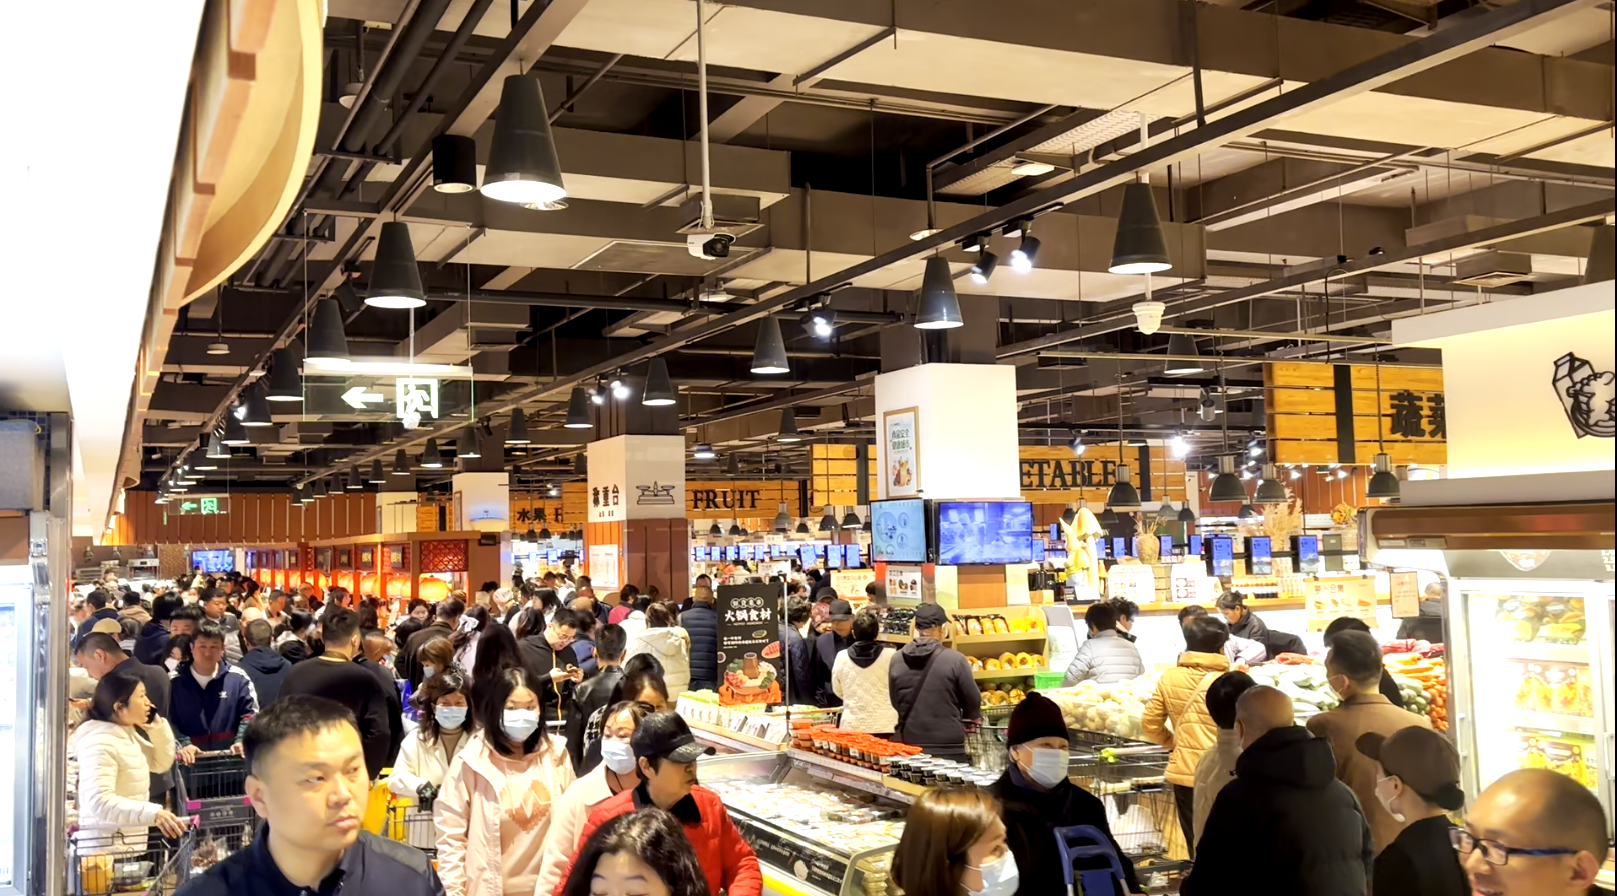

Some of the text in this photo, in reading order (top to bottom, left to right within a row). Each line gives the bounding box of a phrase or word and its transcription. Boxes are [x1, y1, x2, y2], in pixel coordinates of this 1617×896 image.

[1389, 390, 1447, 439] 蔬菜
[1019, 458, 1117, 488] ETABLE
[692, 489, 760, 509] FRUIT
[516, 506, 547, 523] 水果
[724, 607, 772, 623] 火锅食材
